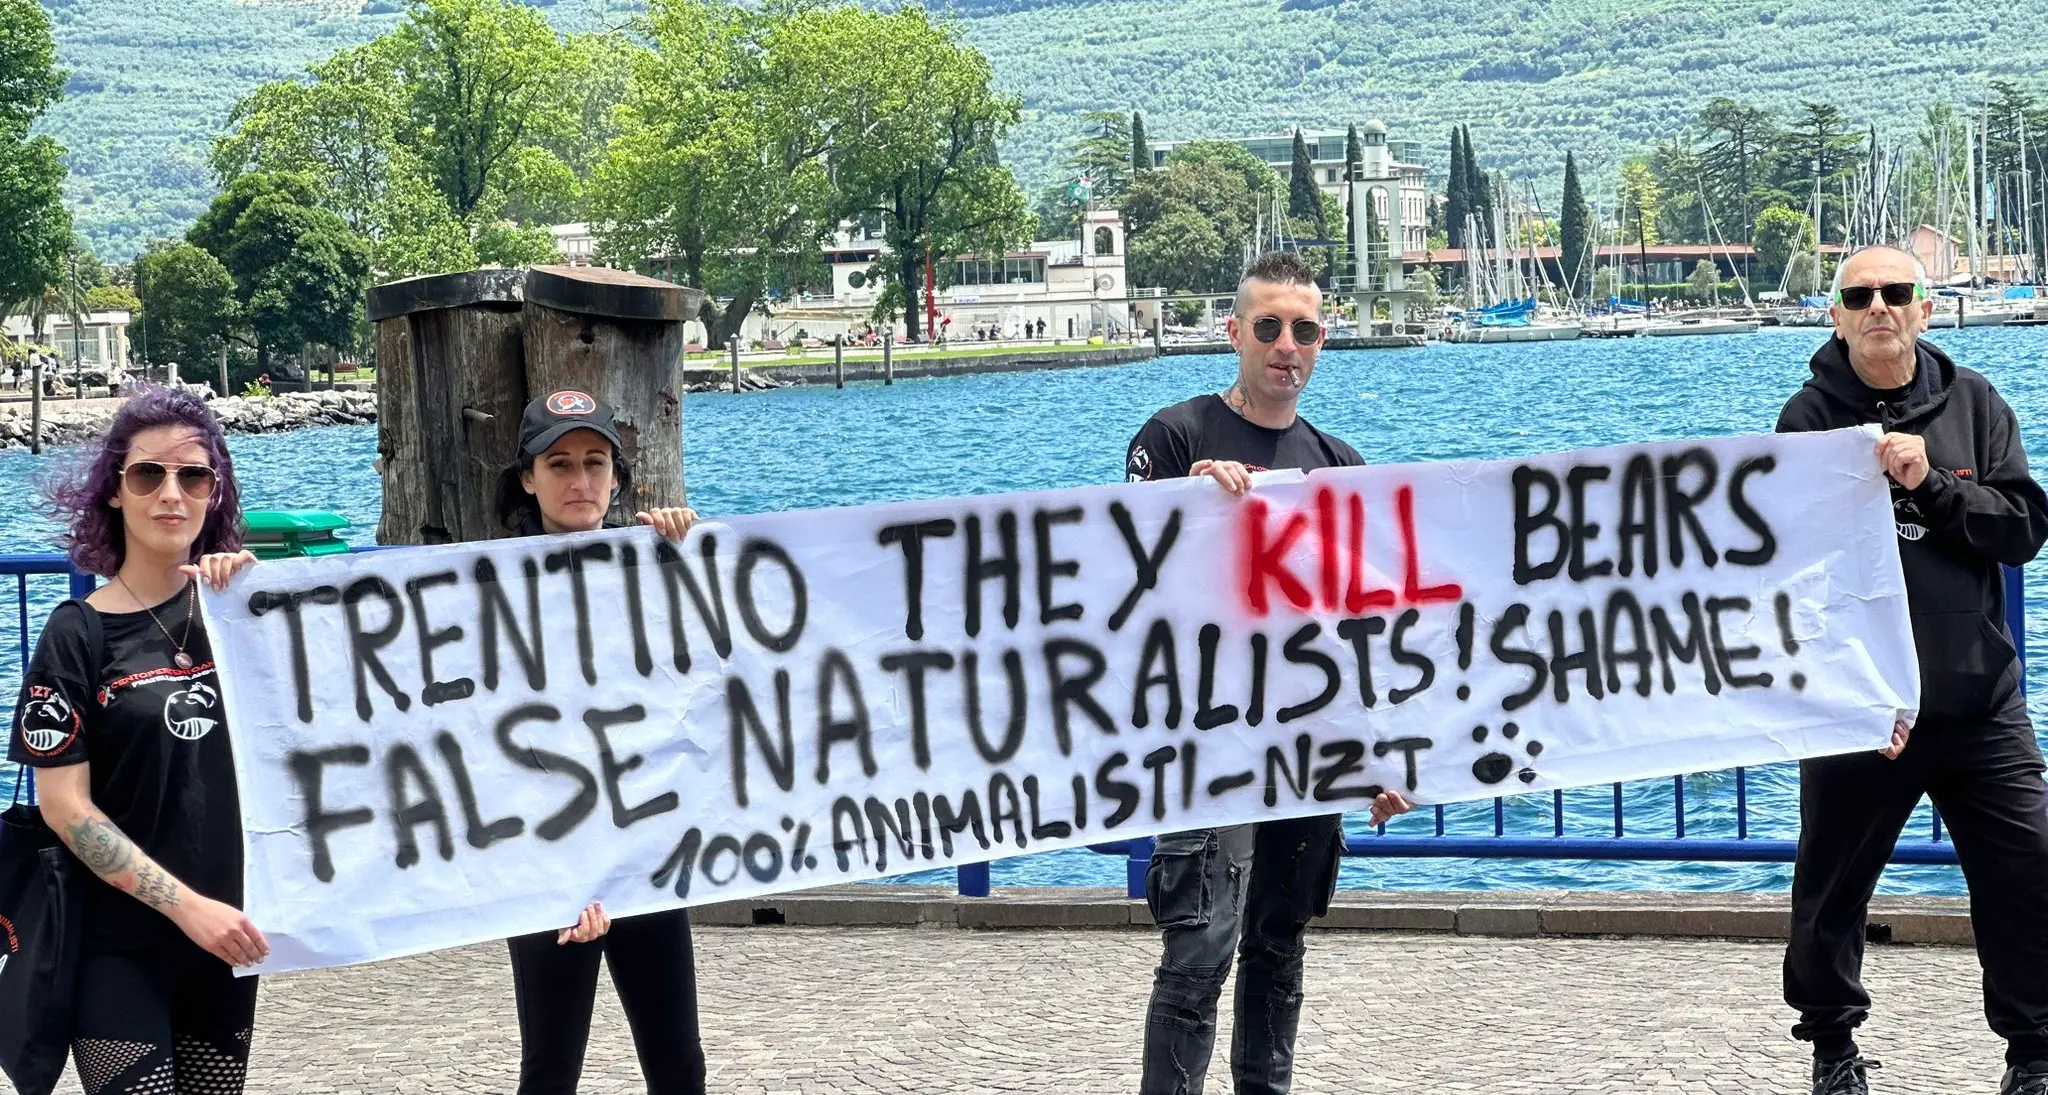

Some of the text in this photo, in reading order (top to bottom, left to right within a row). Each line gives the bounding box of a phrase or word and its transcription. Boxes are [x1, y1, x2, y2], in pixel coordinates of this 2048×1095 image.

[248, 447, 1777, 724] TRENTINO THEY KILL BEARS
[287, 704, 679, 884] FALSE
[1489, 588, 1807, 712] SHAME!
